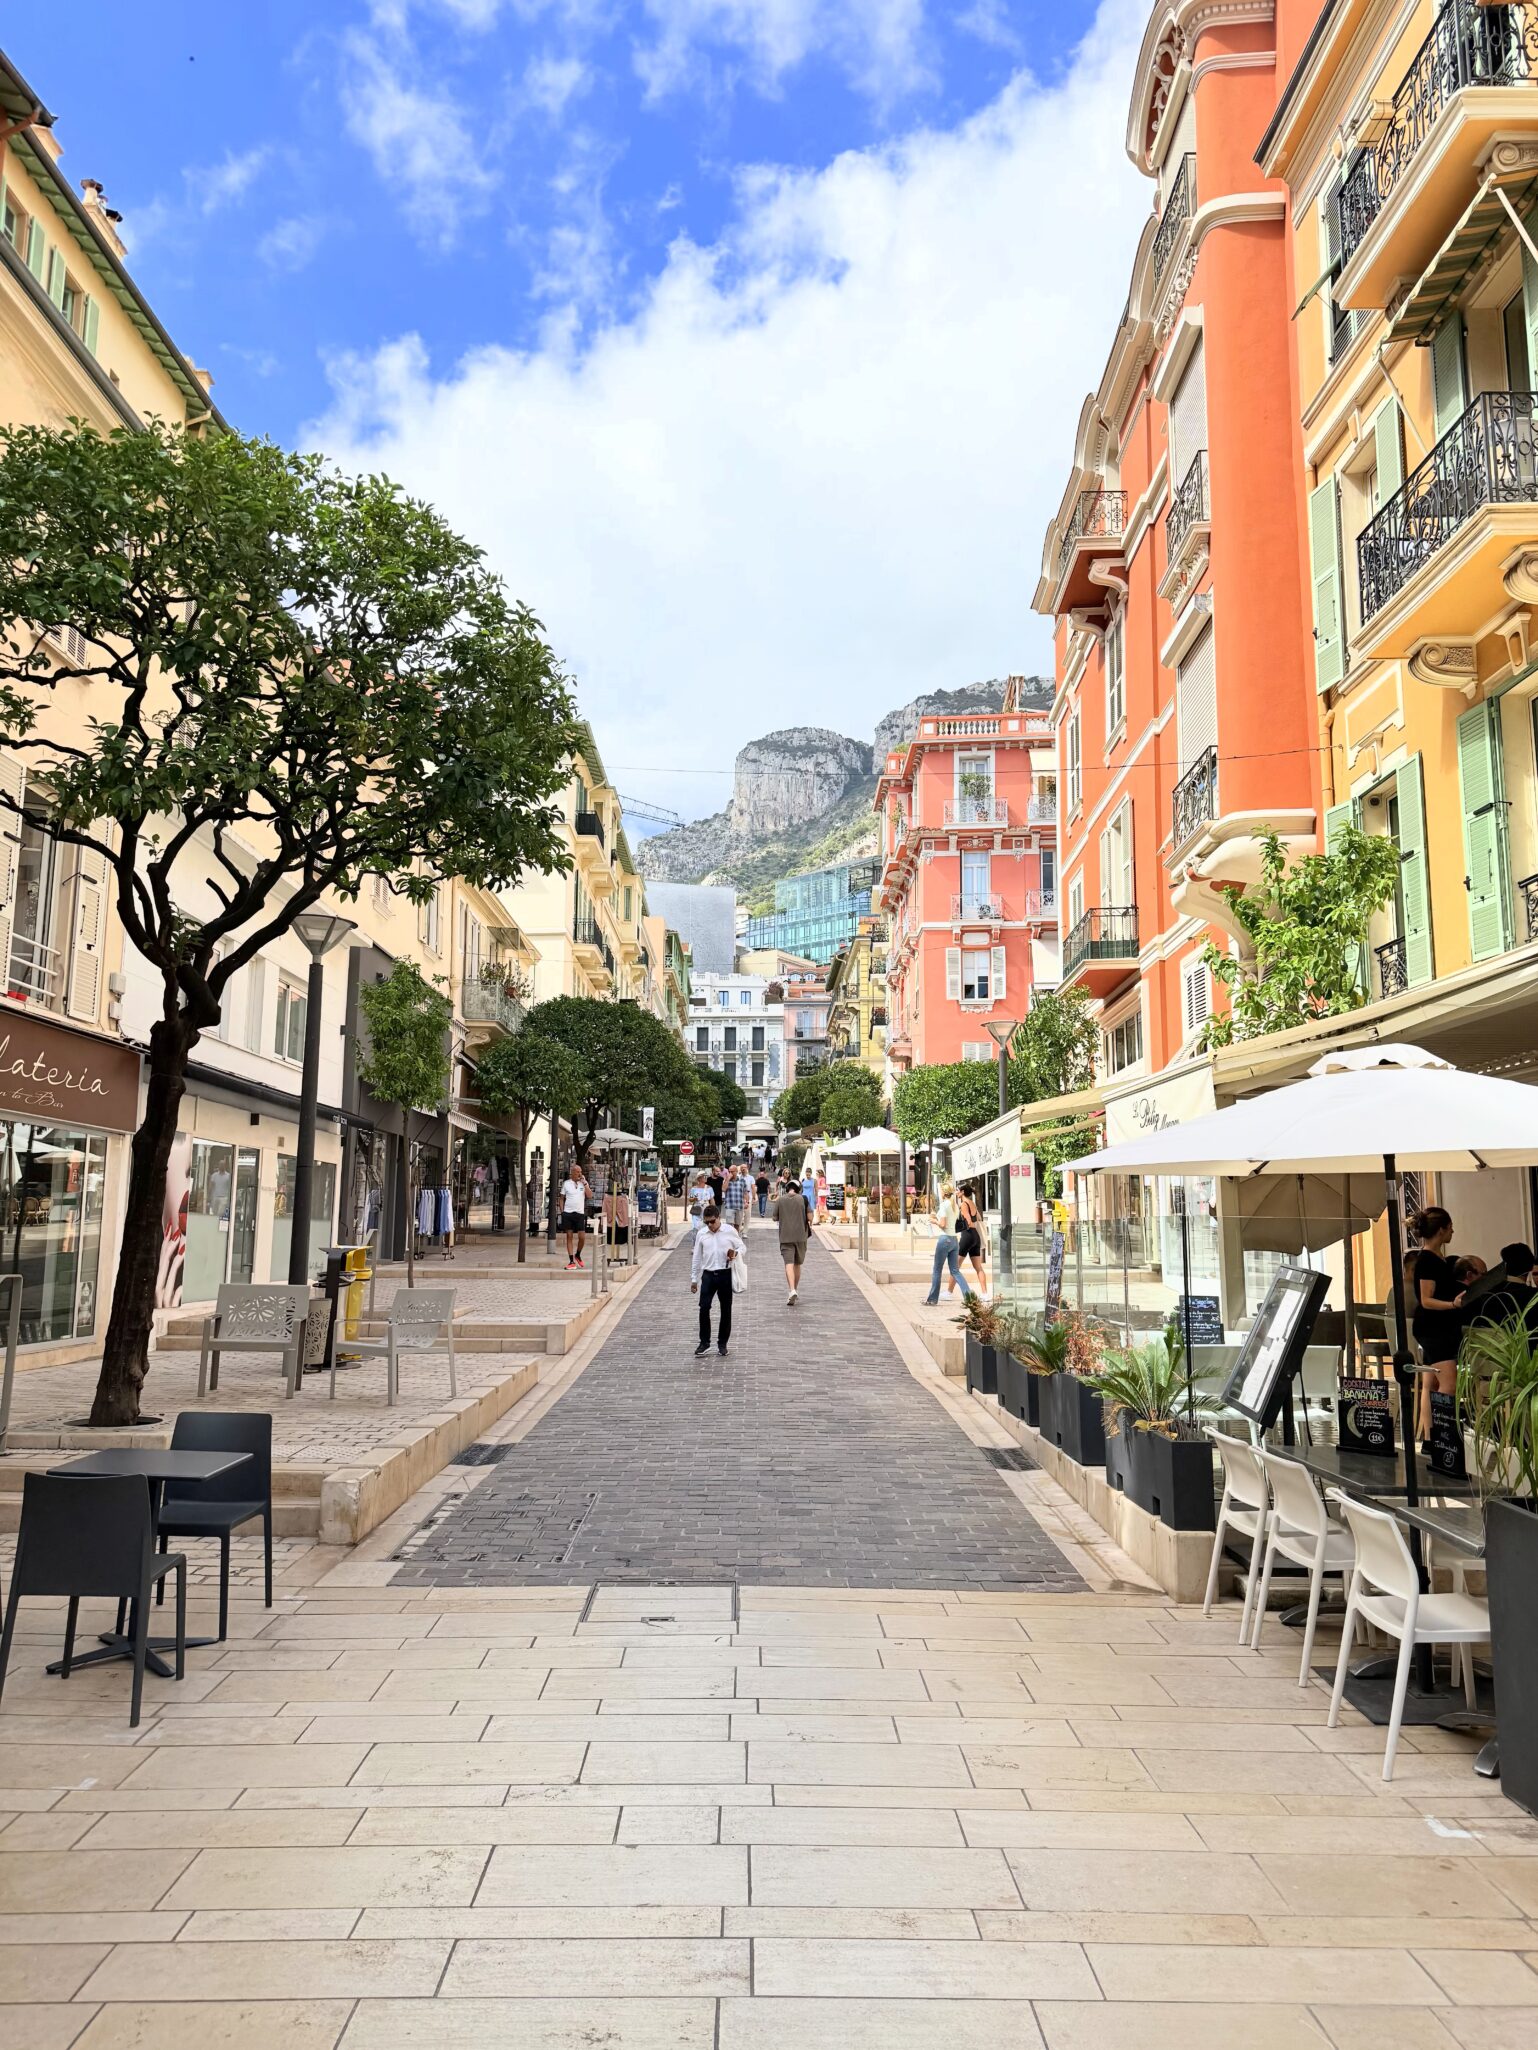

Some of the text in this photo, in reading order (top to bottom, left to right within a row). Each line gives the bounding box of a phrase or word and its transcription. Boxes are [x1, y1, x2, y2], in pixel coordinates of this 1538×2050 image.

[25, 1091, 64, 1109] Bar
[1343, 1380, 1370, 1389] COCKTAIL
[1343, 1389, 1379, 1401] BANANA
